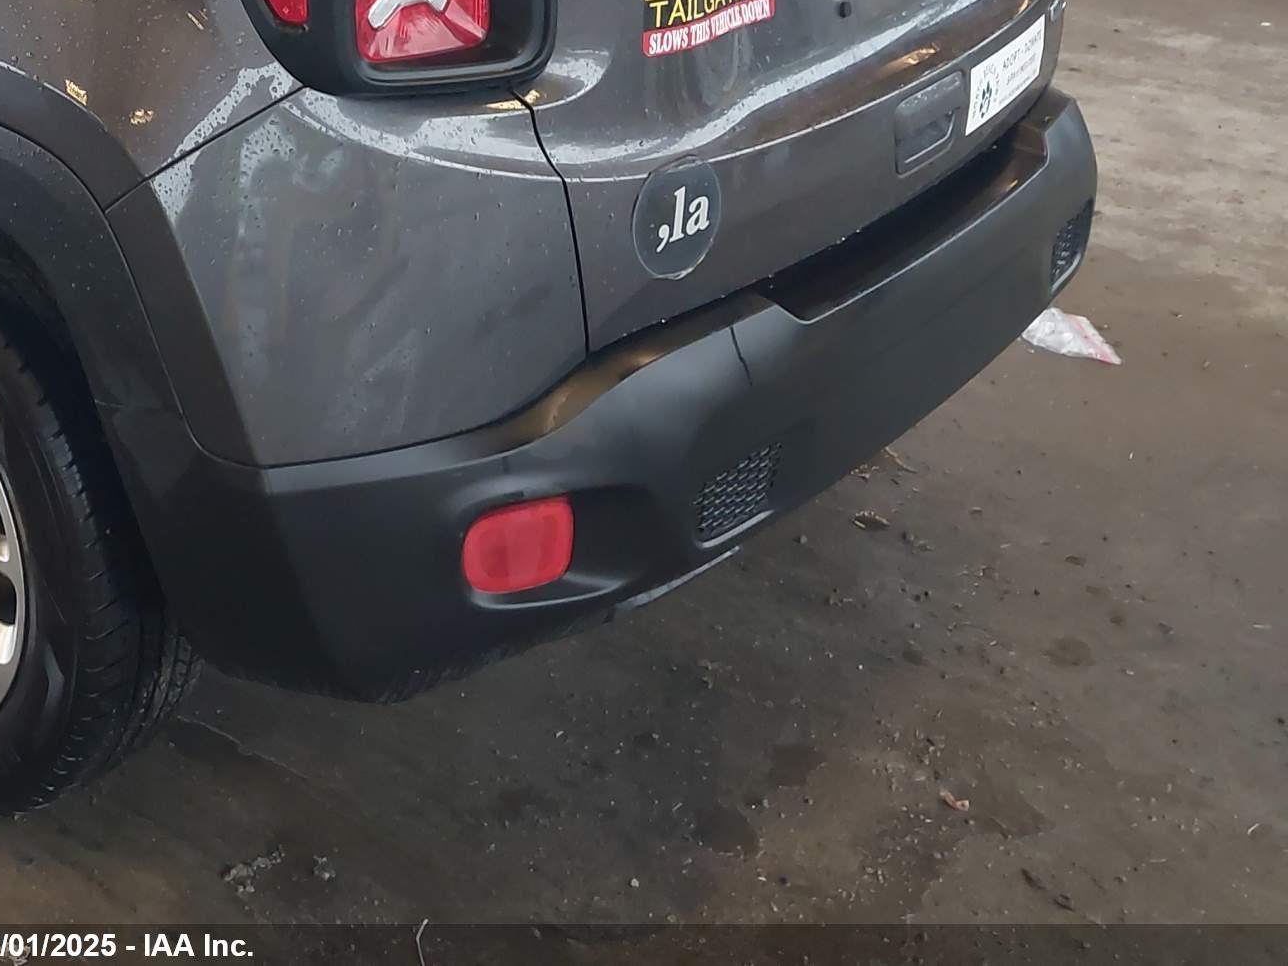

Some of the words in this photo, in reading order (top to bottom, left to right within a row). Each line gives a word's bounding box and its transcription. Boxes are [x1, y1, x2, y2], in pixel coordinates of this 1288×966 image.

[648, 27, 689, 54] SLOWS
[690, 19, 711, 46] THIS
[710, 3, 741, 37] VEHICLE
